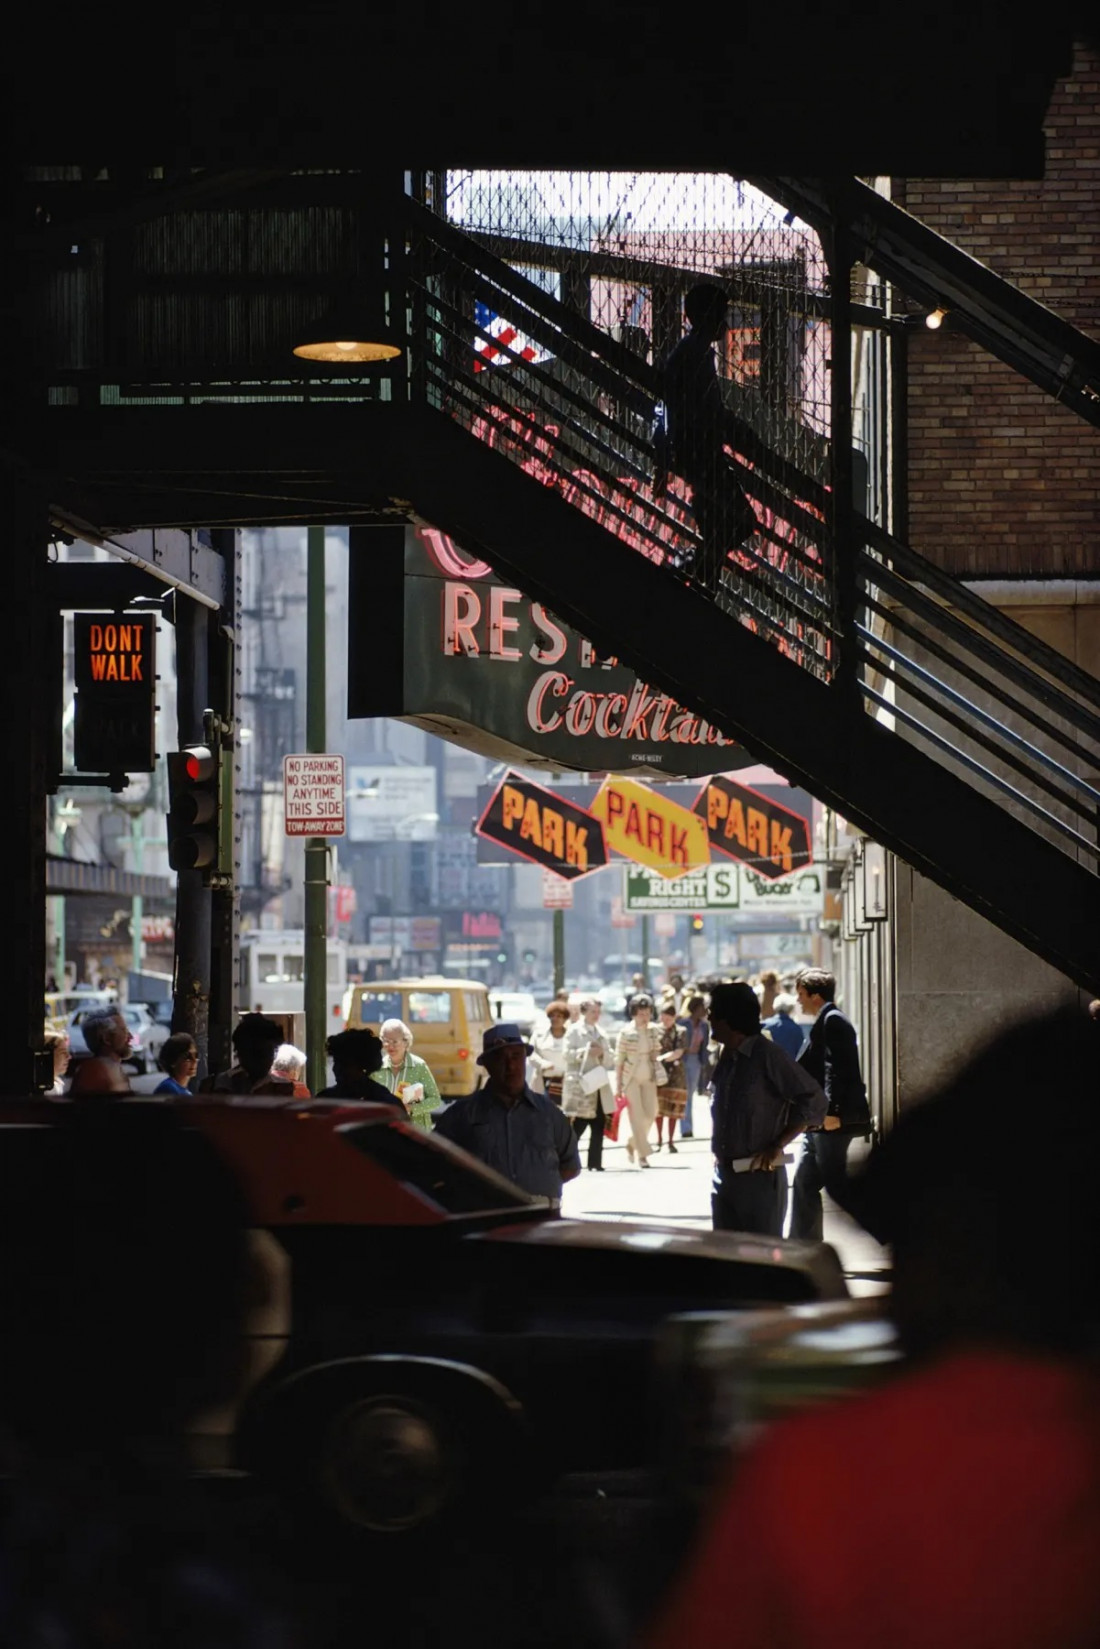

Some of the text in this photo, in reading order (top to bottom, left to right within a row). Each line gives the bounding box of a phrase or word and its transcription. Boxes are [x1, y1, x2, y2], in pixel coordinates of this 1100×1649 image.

[90, 624, 144, 652] DONT
[90, 654, 143, 681] WALK
[289, 760, 339, 772] NO PARKING
[287, 774, 342, 786] NO STANDING
[292, 788, 336, 800] ANYTIME
[288, 801, 342, 816] THIS SIDE
[503, 784, 588, 873] PARK
[606, 787, 689, 873] PARK
[707, 785, 793, 872] PARK
[648, 879, 706, 896] RIGHT
